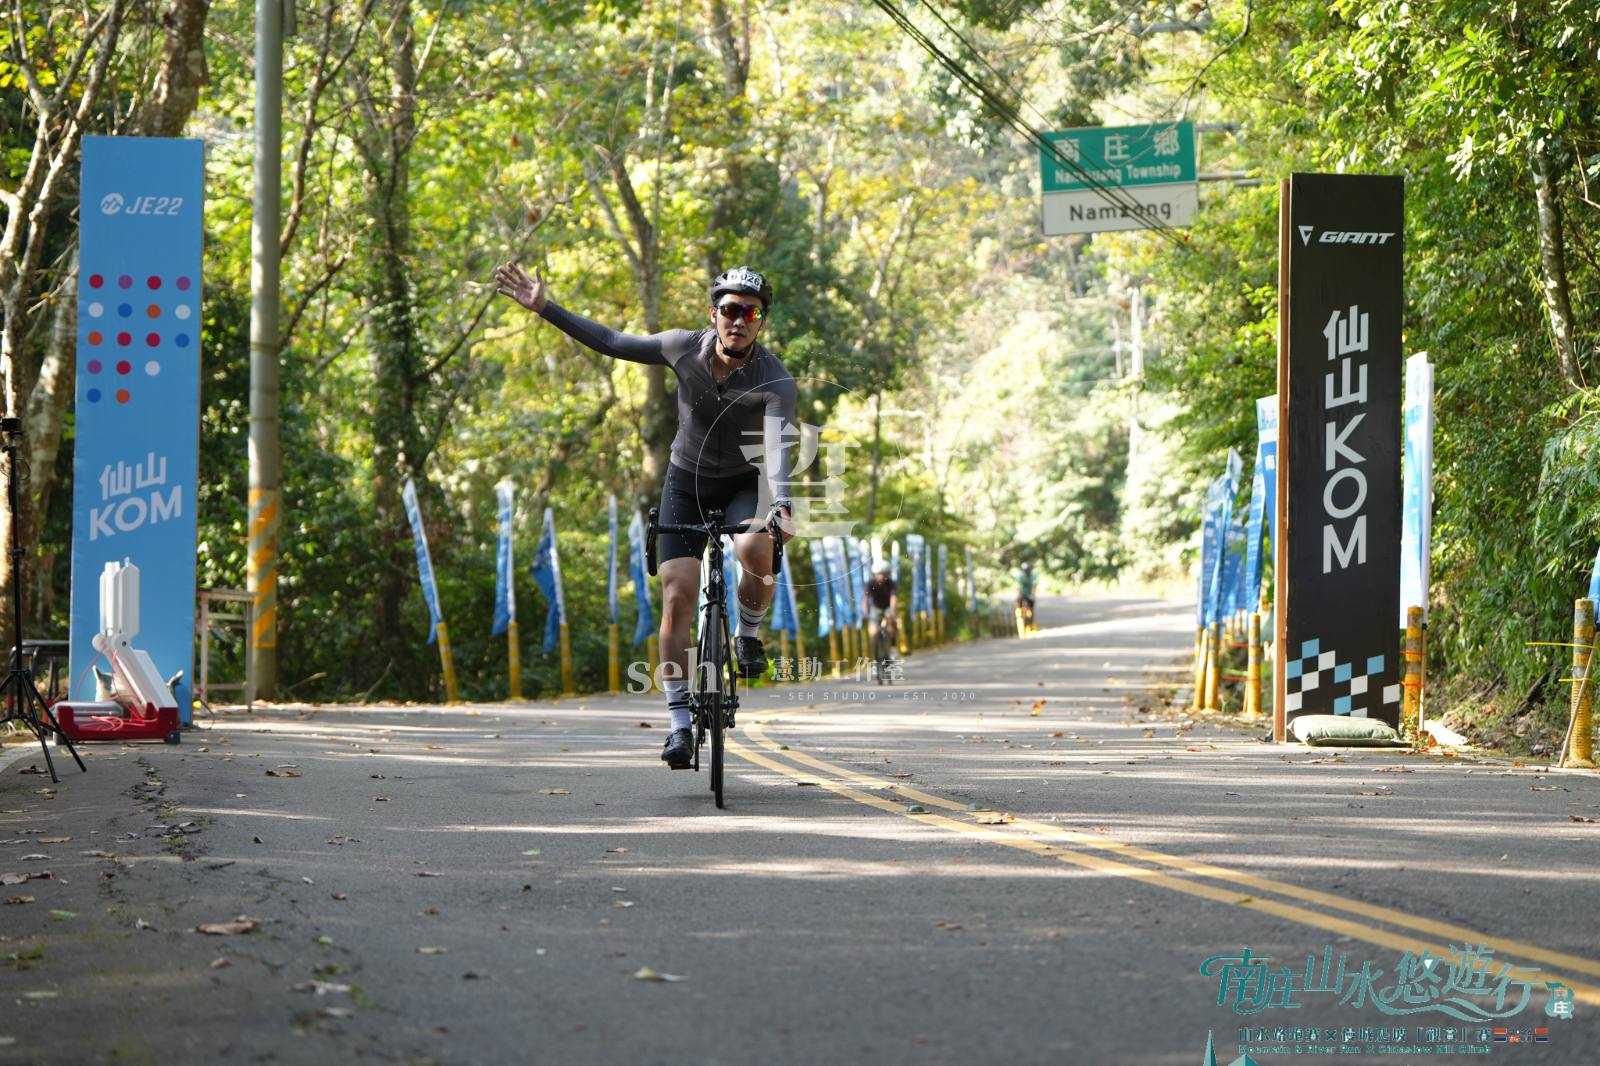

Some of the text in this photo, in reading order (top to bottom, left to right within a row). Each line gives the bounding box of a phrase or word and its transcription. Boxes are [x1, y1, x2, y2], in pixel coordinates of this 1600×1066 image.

[1126, 163, 1181, 179] Township
[125, 197, 184, 215] JE22
[1069, 202, 1172, 222] Namzong
[1318, 231, 1396, 244] GIANT
[99, 452, 168, 501] 仙山
[89, 484, 183, 541] KOM
